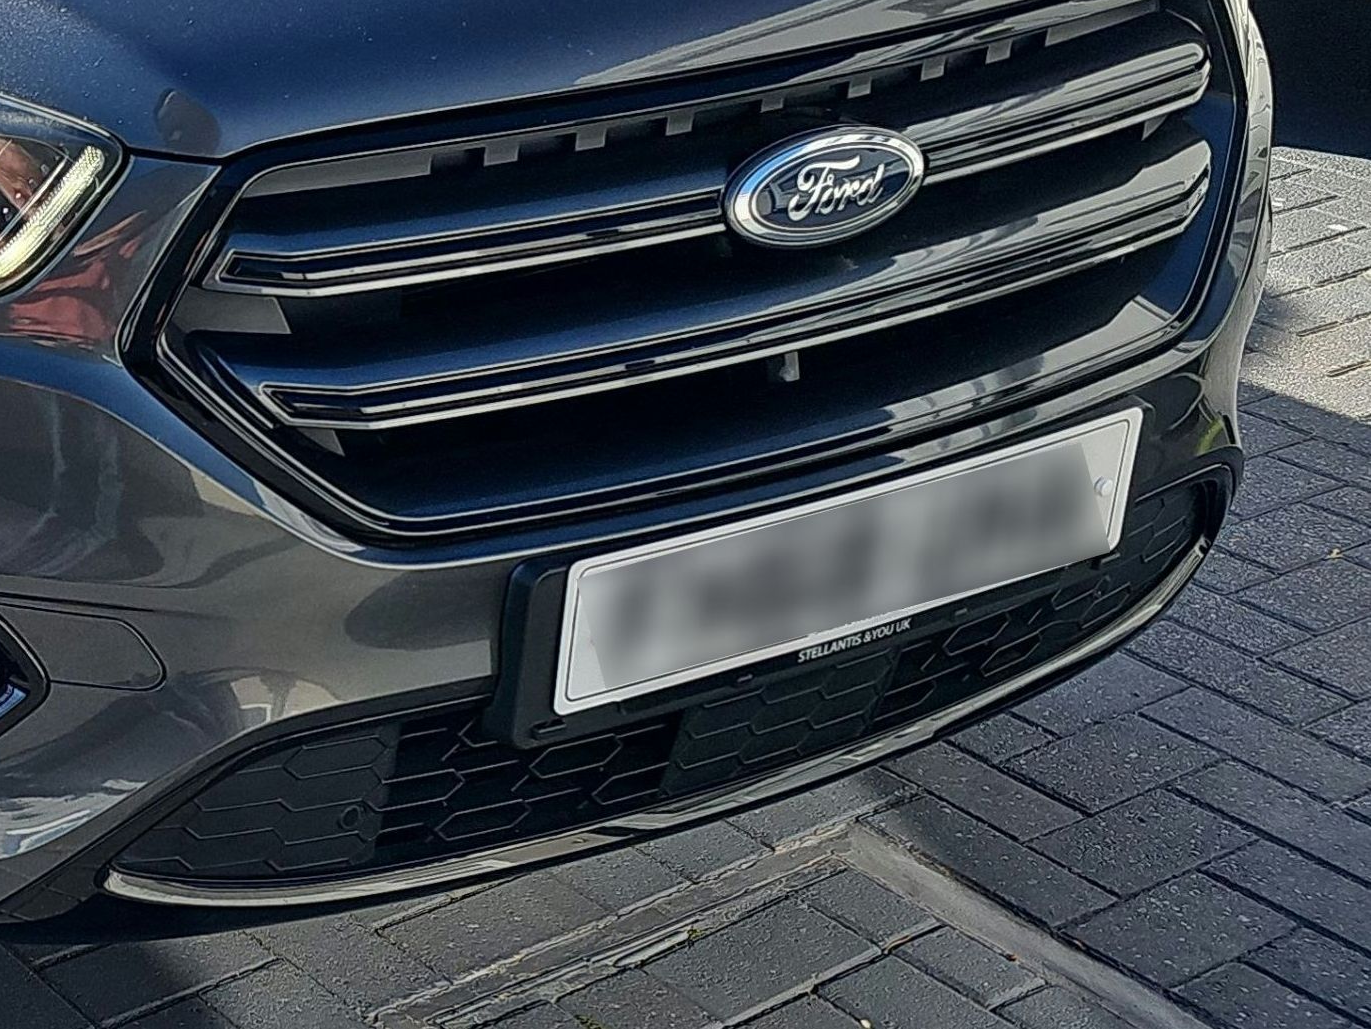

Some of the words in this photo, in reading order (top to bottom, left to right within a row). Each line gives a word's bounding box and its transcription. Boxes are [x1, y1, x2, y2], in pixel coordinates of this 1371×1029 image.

[787, 154, 885, 222] Ford
[797, 633, 863, 663] STELLANTIS
[895, 618, 912, 632] UK
